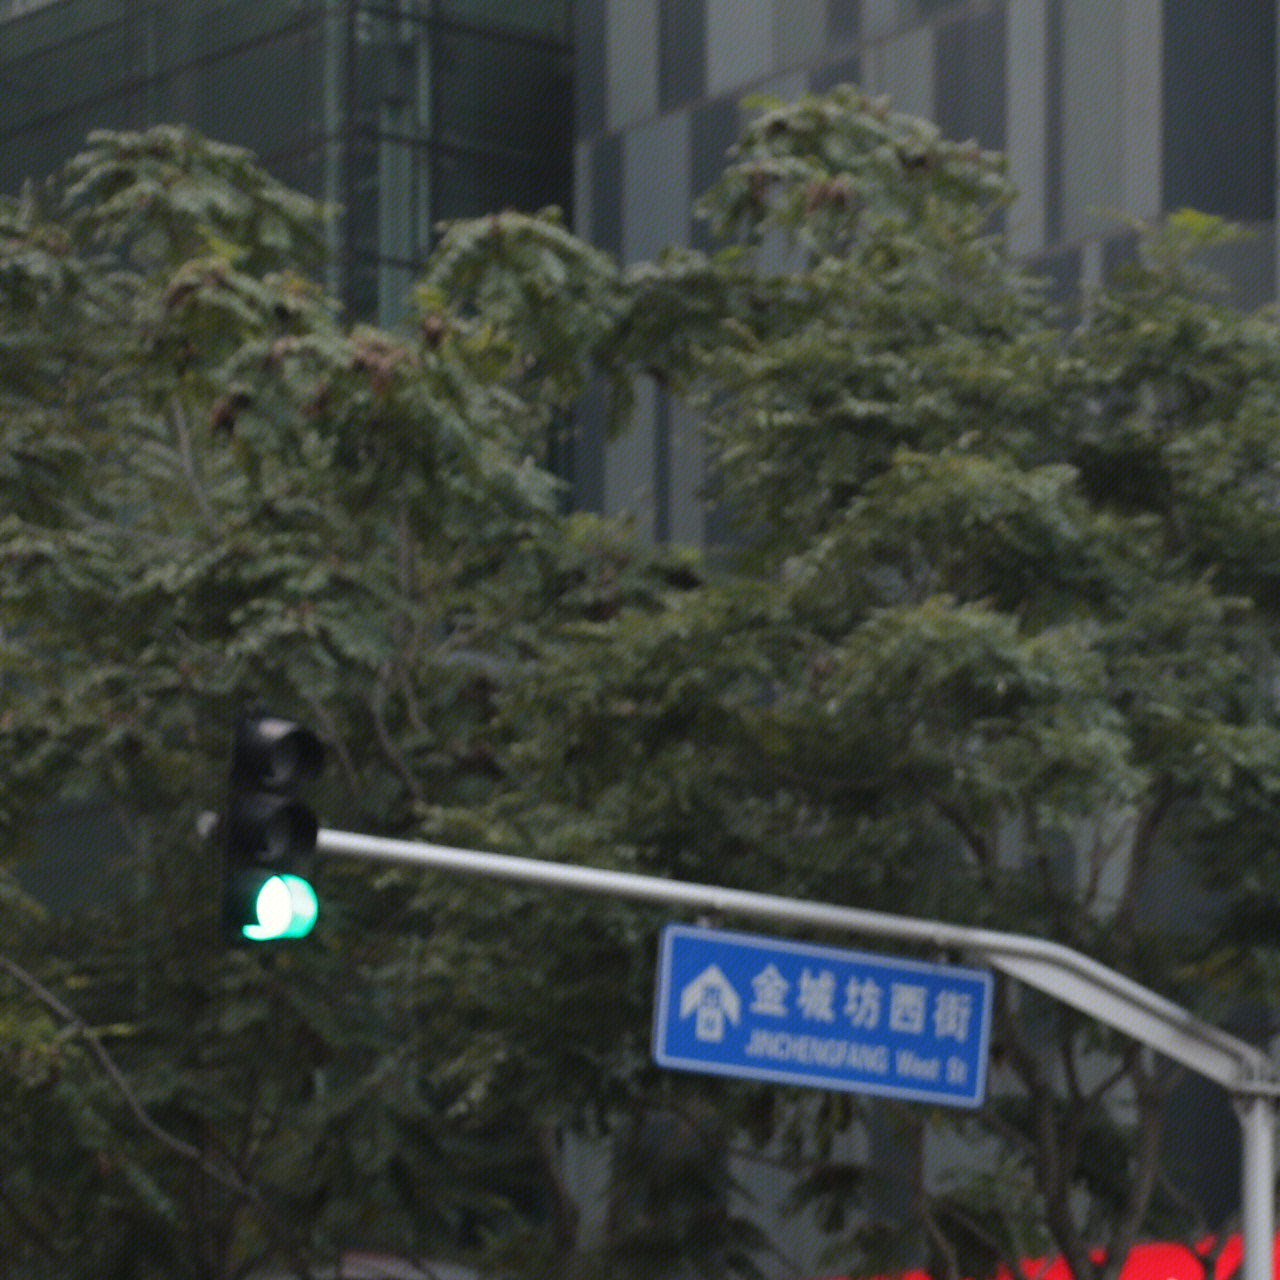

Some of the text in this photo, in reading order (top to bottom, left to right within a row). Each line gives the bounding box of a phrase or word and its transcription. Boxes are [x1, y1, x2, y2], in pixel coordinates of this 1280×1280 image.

[750, 963, 973, 1043] 金城坊西街
